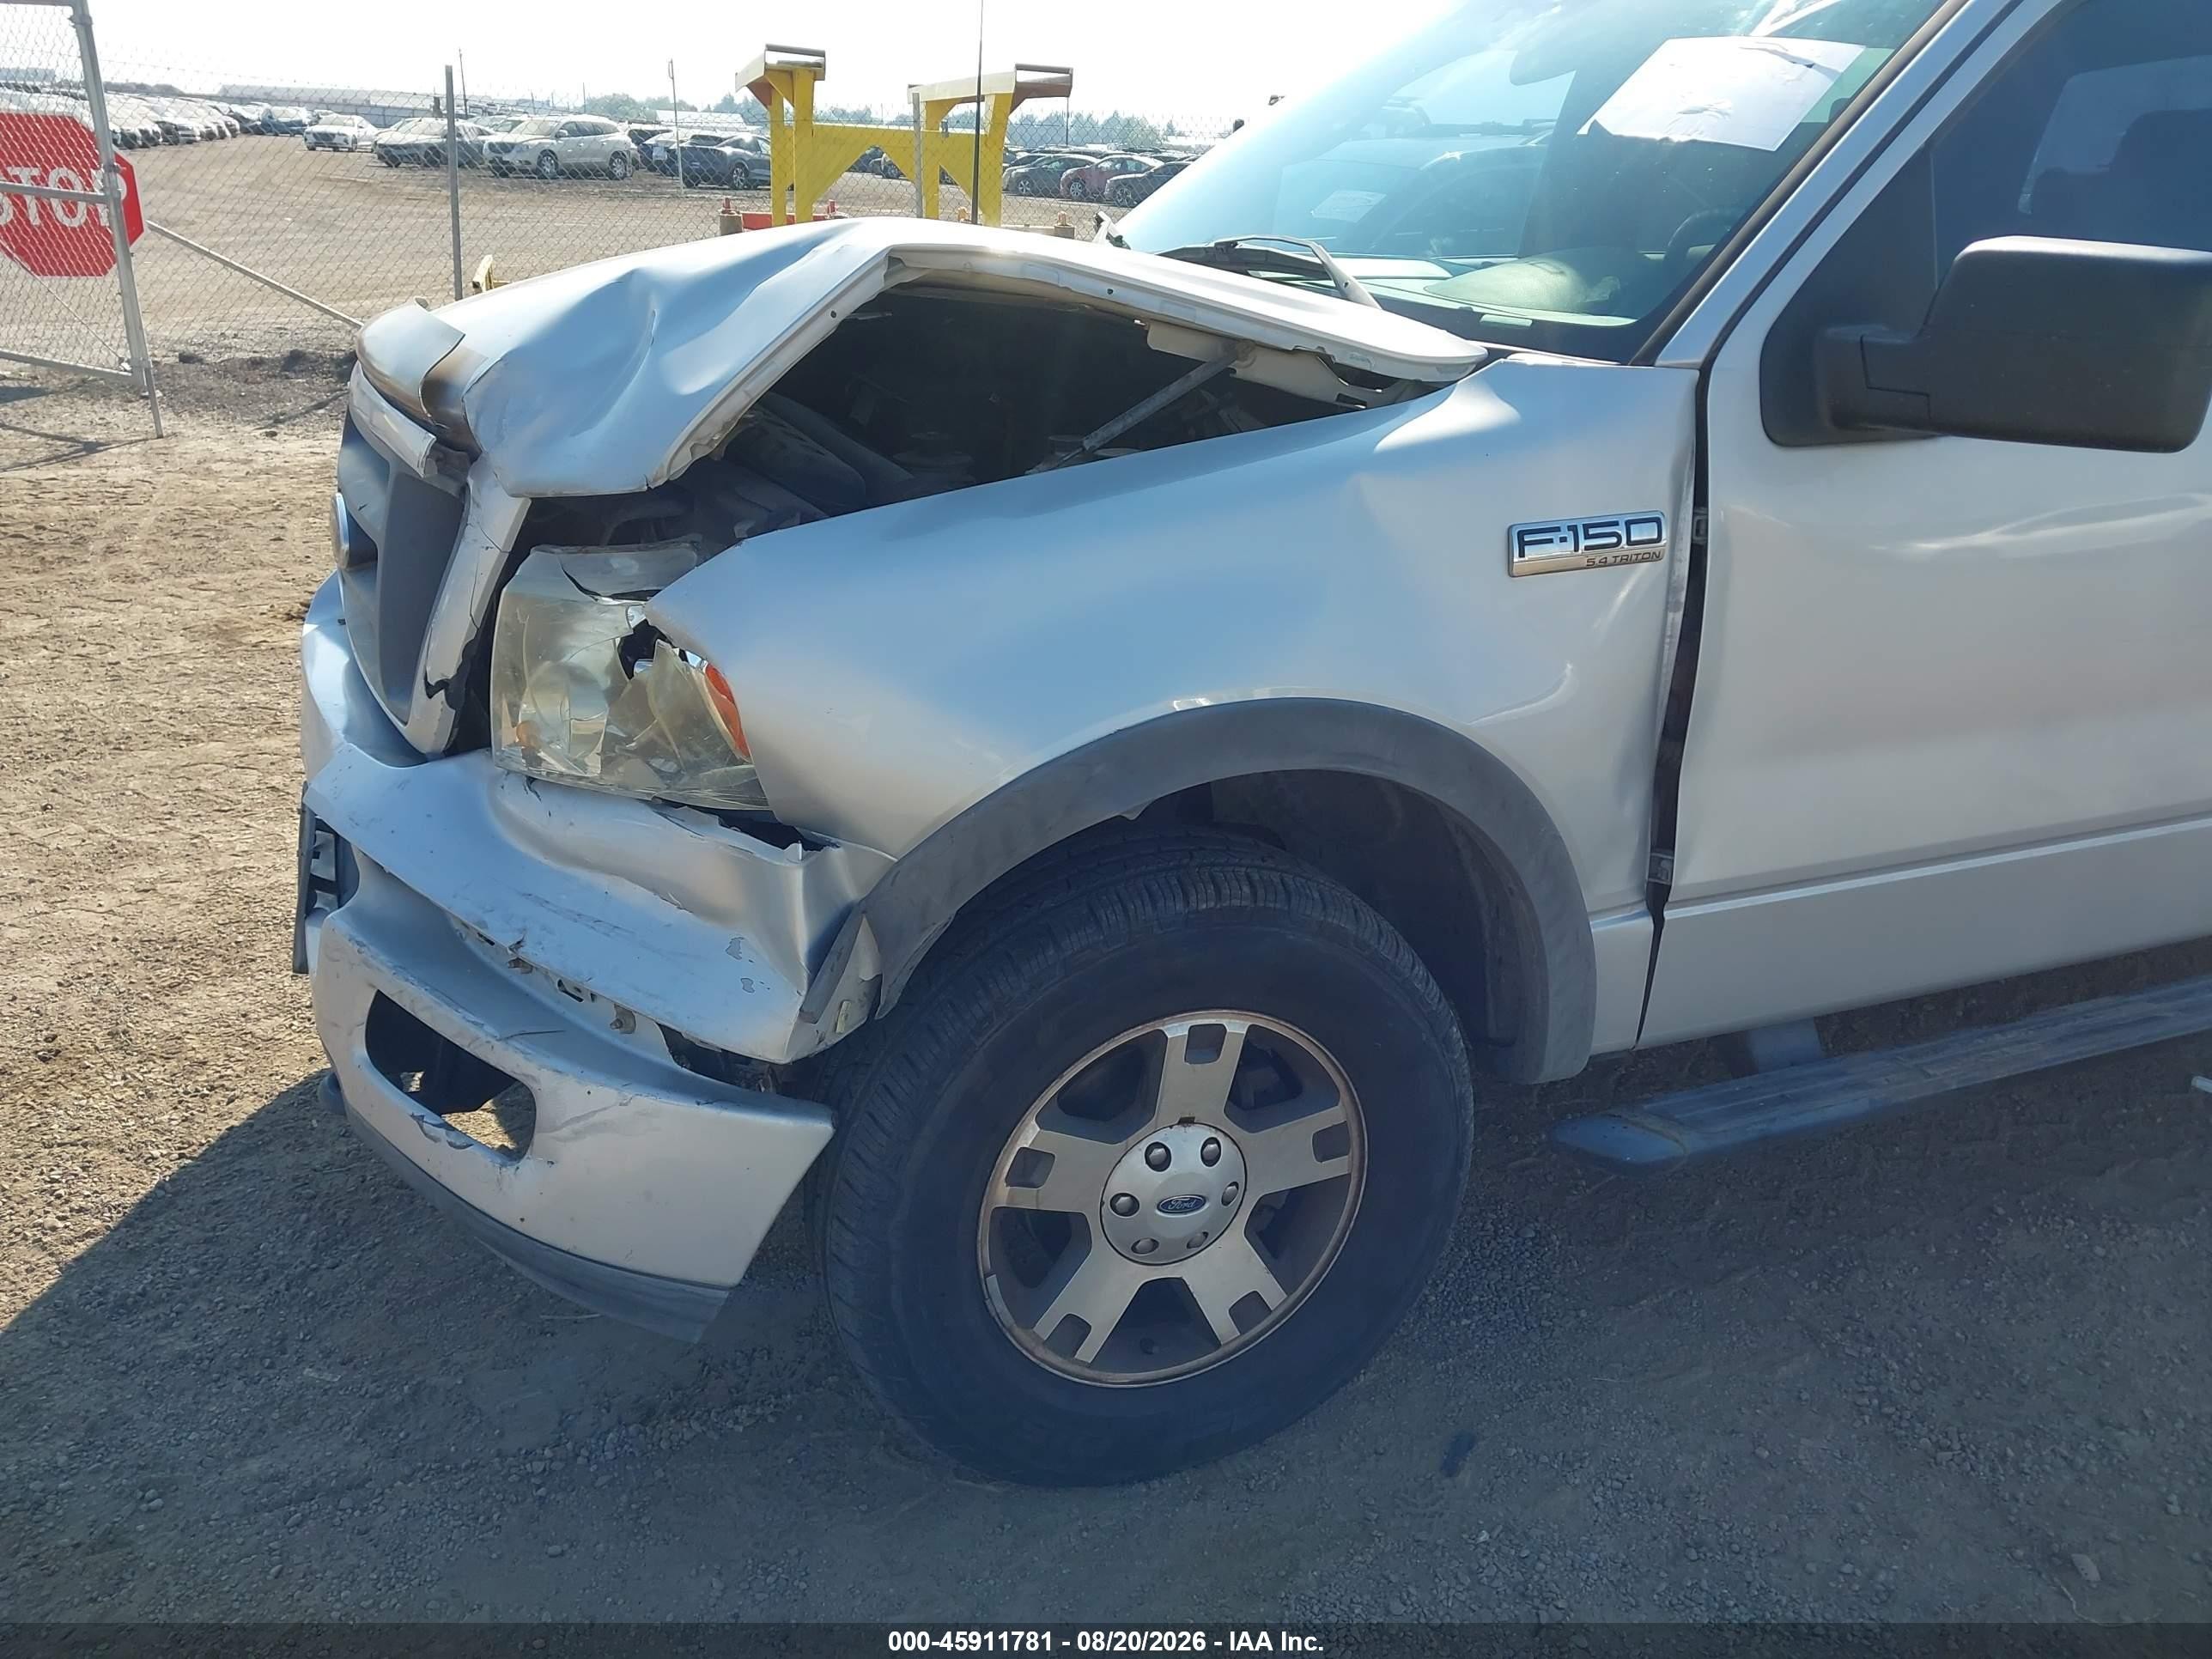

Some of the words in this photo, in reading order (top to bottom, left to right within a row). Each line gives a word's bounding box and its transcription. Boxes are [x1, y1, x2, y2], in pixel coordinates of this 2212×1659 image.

[1516, 516, 1662, 558] F-150
[1612, 550, 1662, 564] TRITON
[1168, 1197, 1197, 1210] Ford
